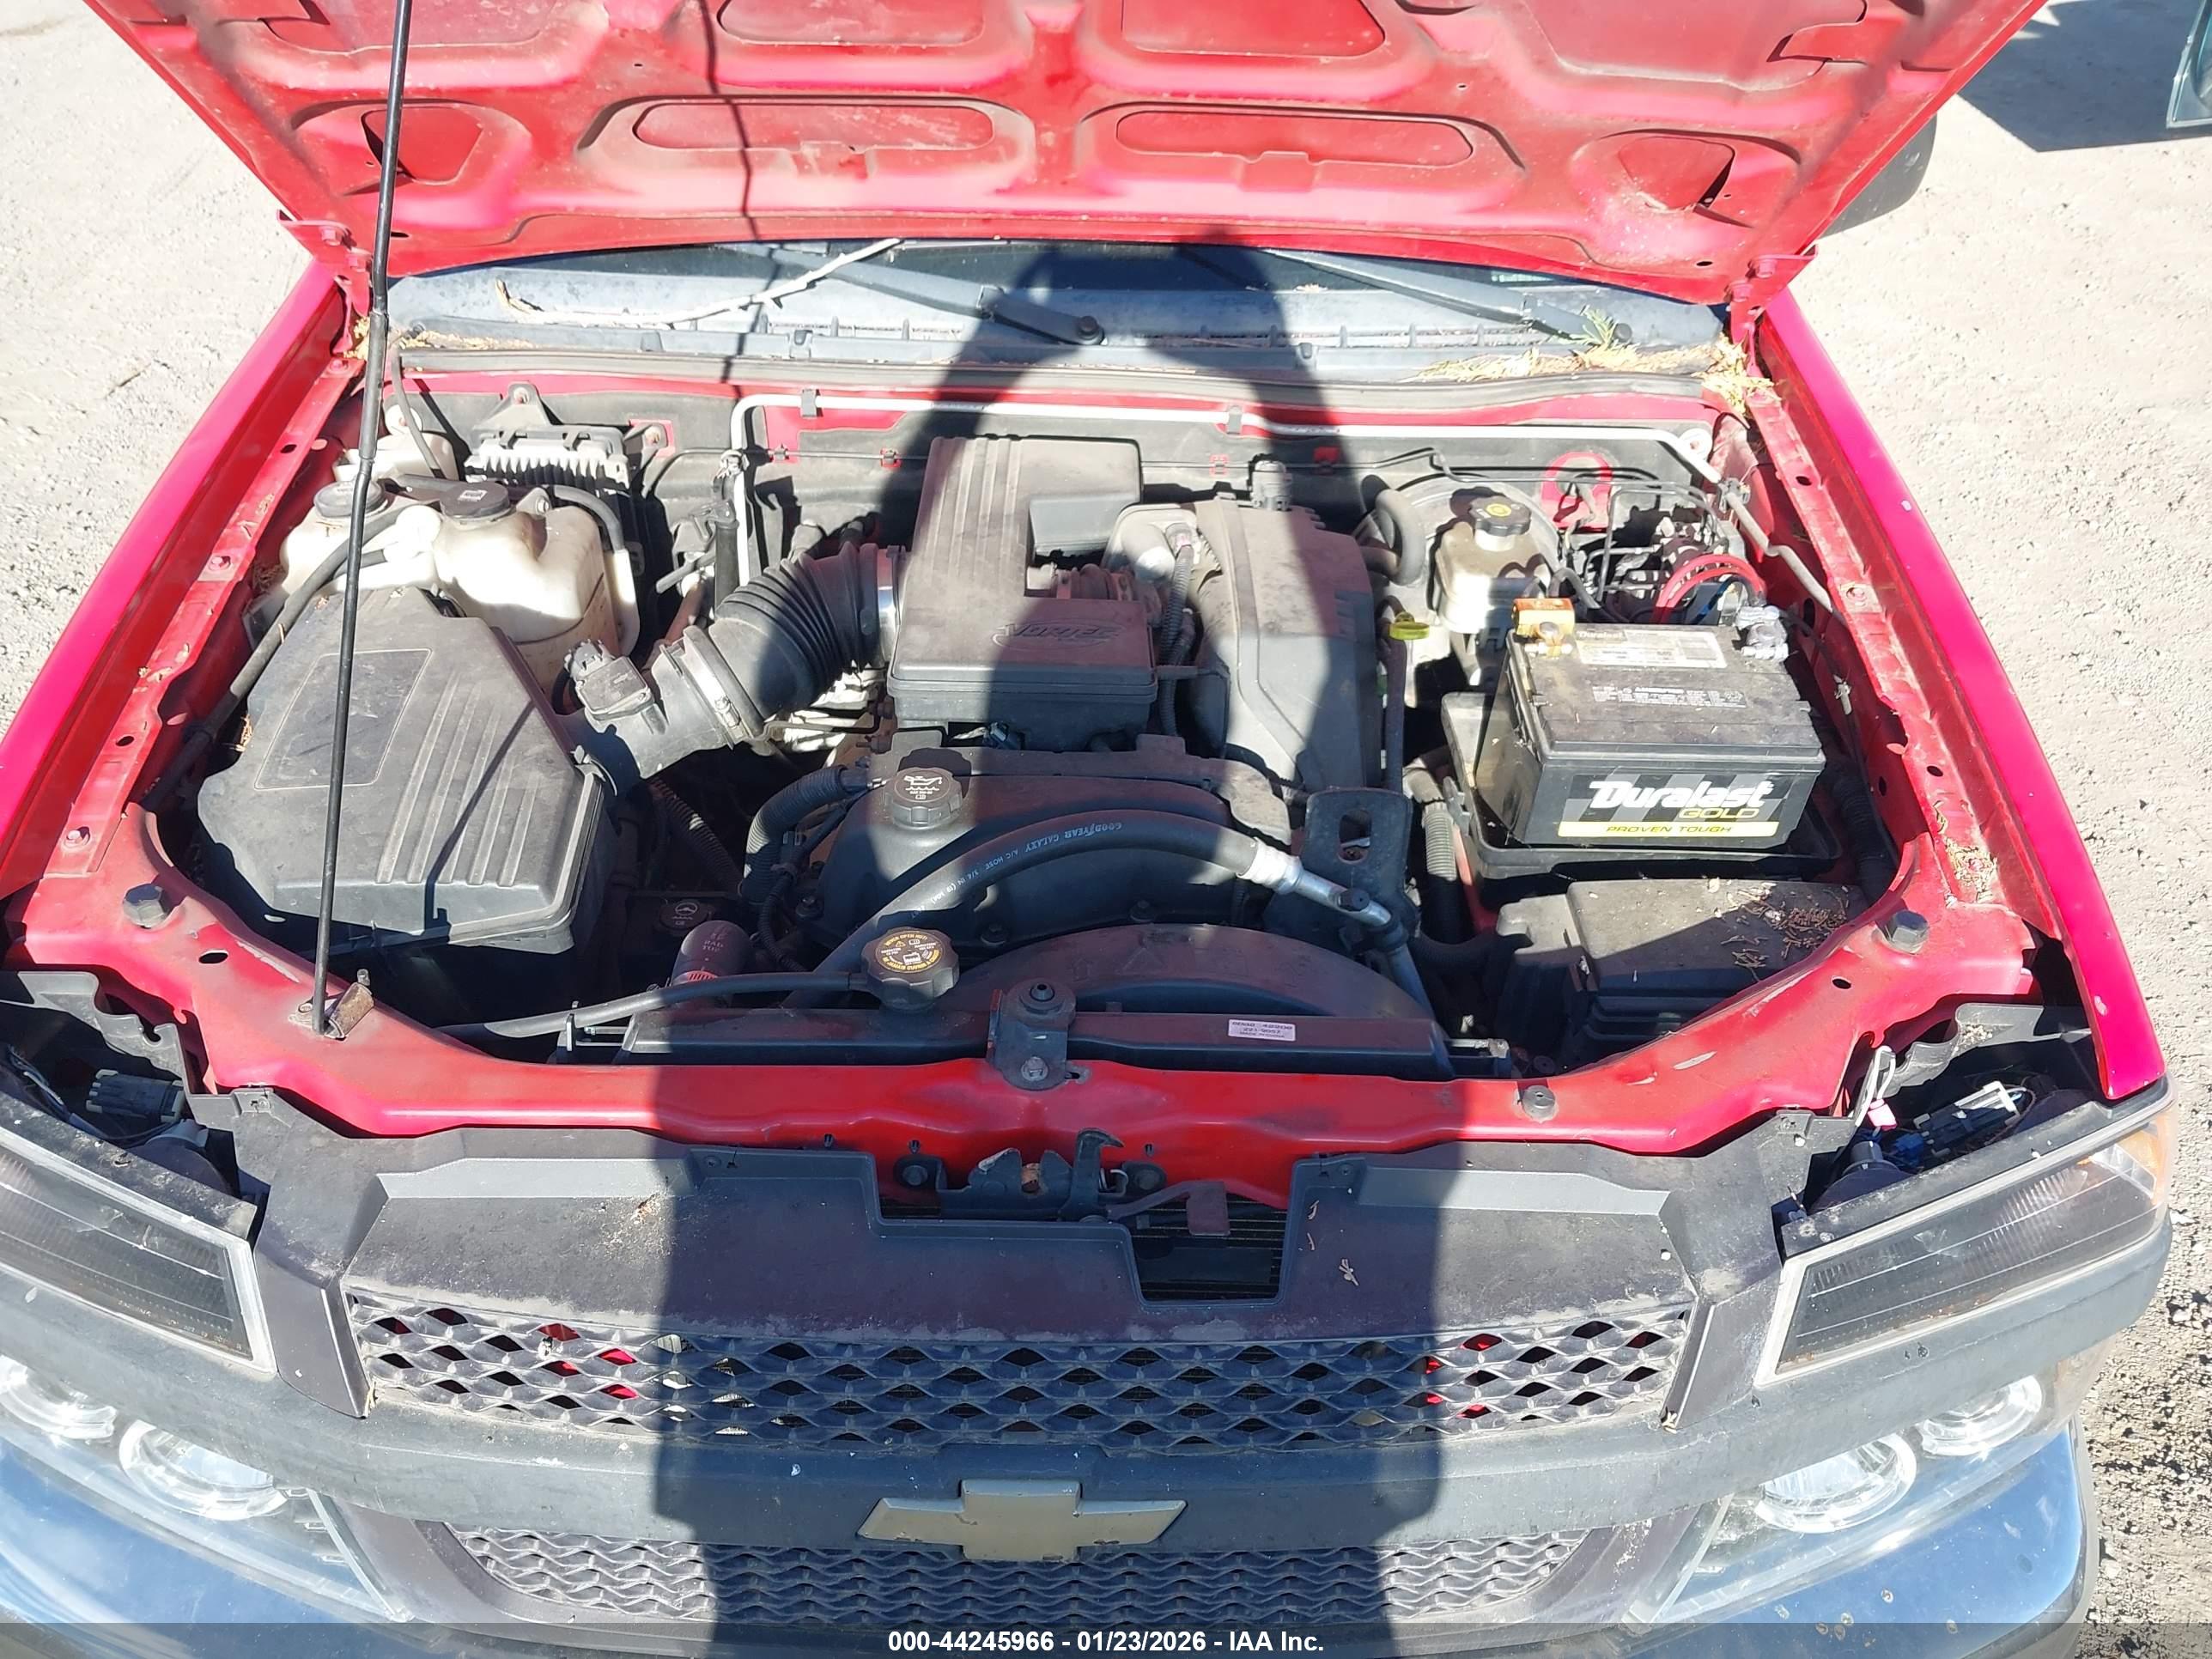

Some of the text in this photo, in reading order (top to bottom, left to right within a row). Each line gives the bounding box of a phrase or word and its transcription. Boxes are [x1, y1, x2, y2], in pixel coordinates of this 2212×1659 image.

[1589, 781, 1775, 808] Duralast
[1677, 807, 1759, 819] GOLD
[1064, 822, 1122, 839] GOODYEAR
[1024, 833, 1060, 853] GALAXY
[984, 857, 1004, 870] HOSE
